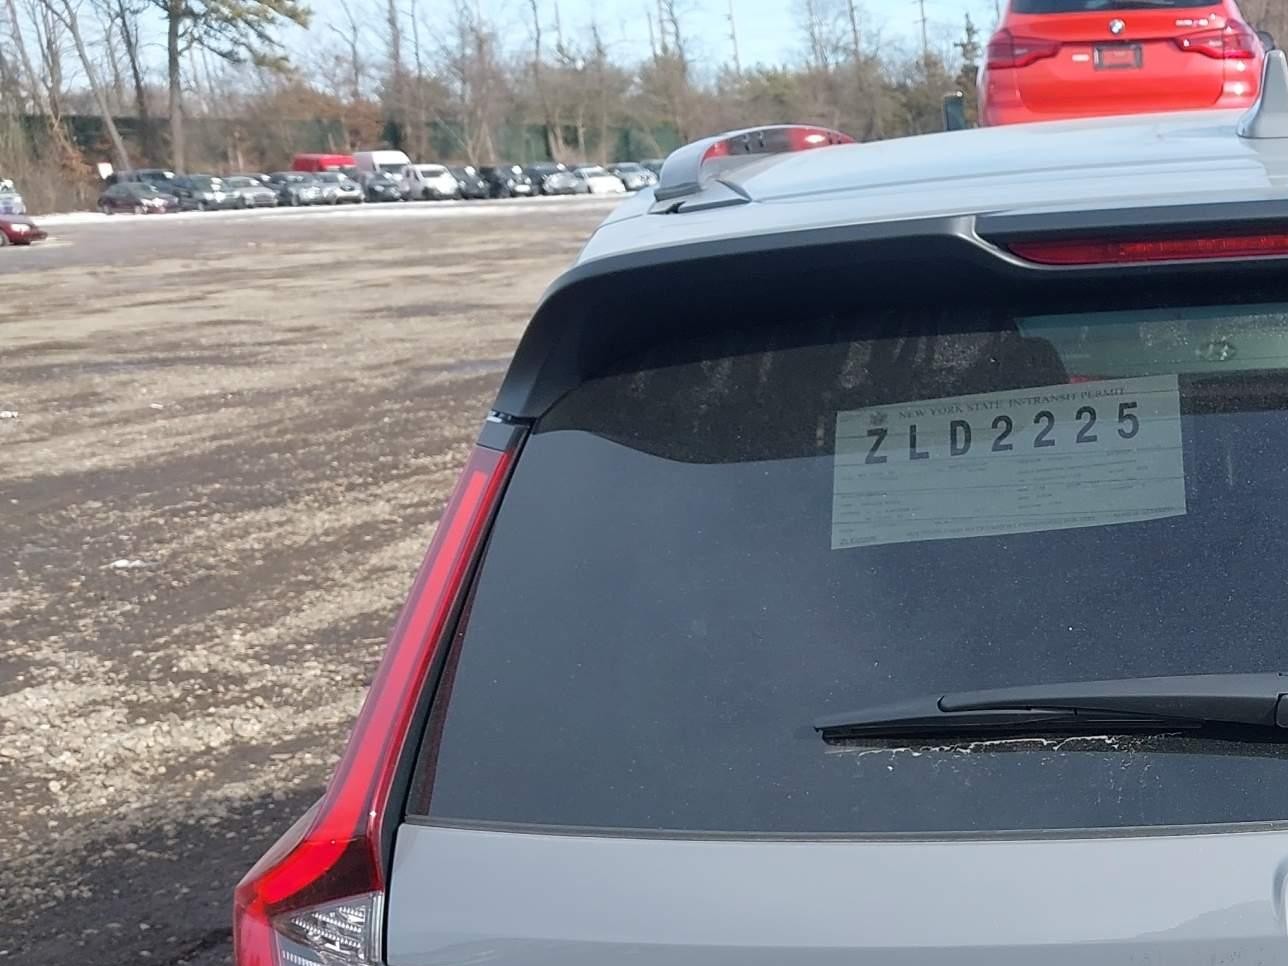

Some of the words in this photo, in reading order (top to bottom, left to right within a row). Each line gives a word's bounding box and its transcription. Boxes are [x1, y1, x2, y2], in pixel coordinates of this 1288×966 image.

[898, 409, 925, 420] NEW
[929, 405, 963, 417] YORK
[966, 400, 1003, 412] STATE
[1080, 387, 1126, 399] PERMIT
[865, 401, 1140, 465] ZLD2225
